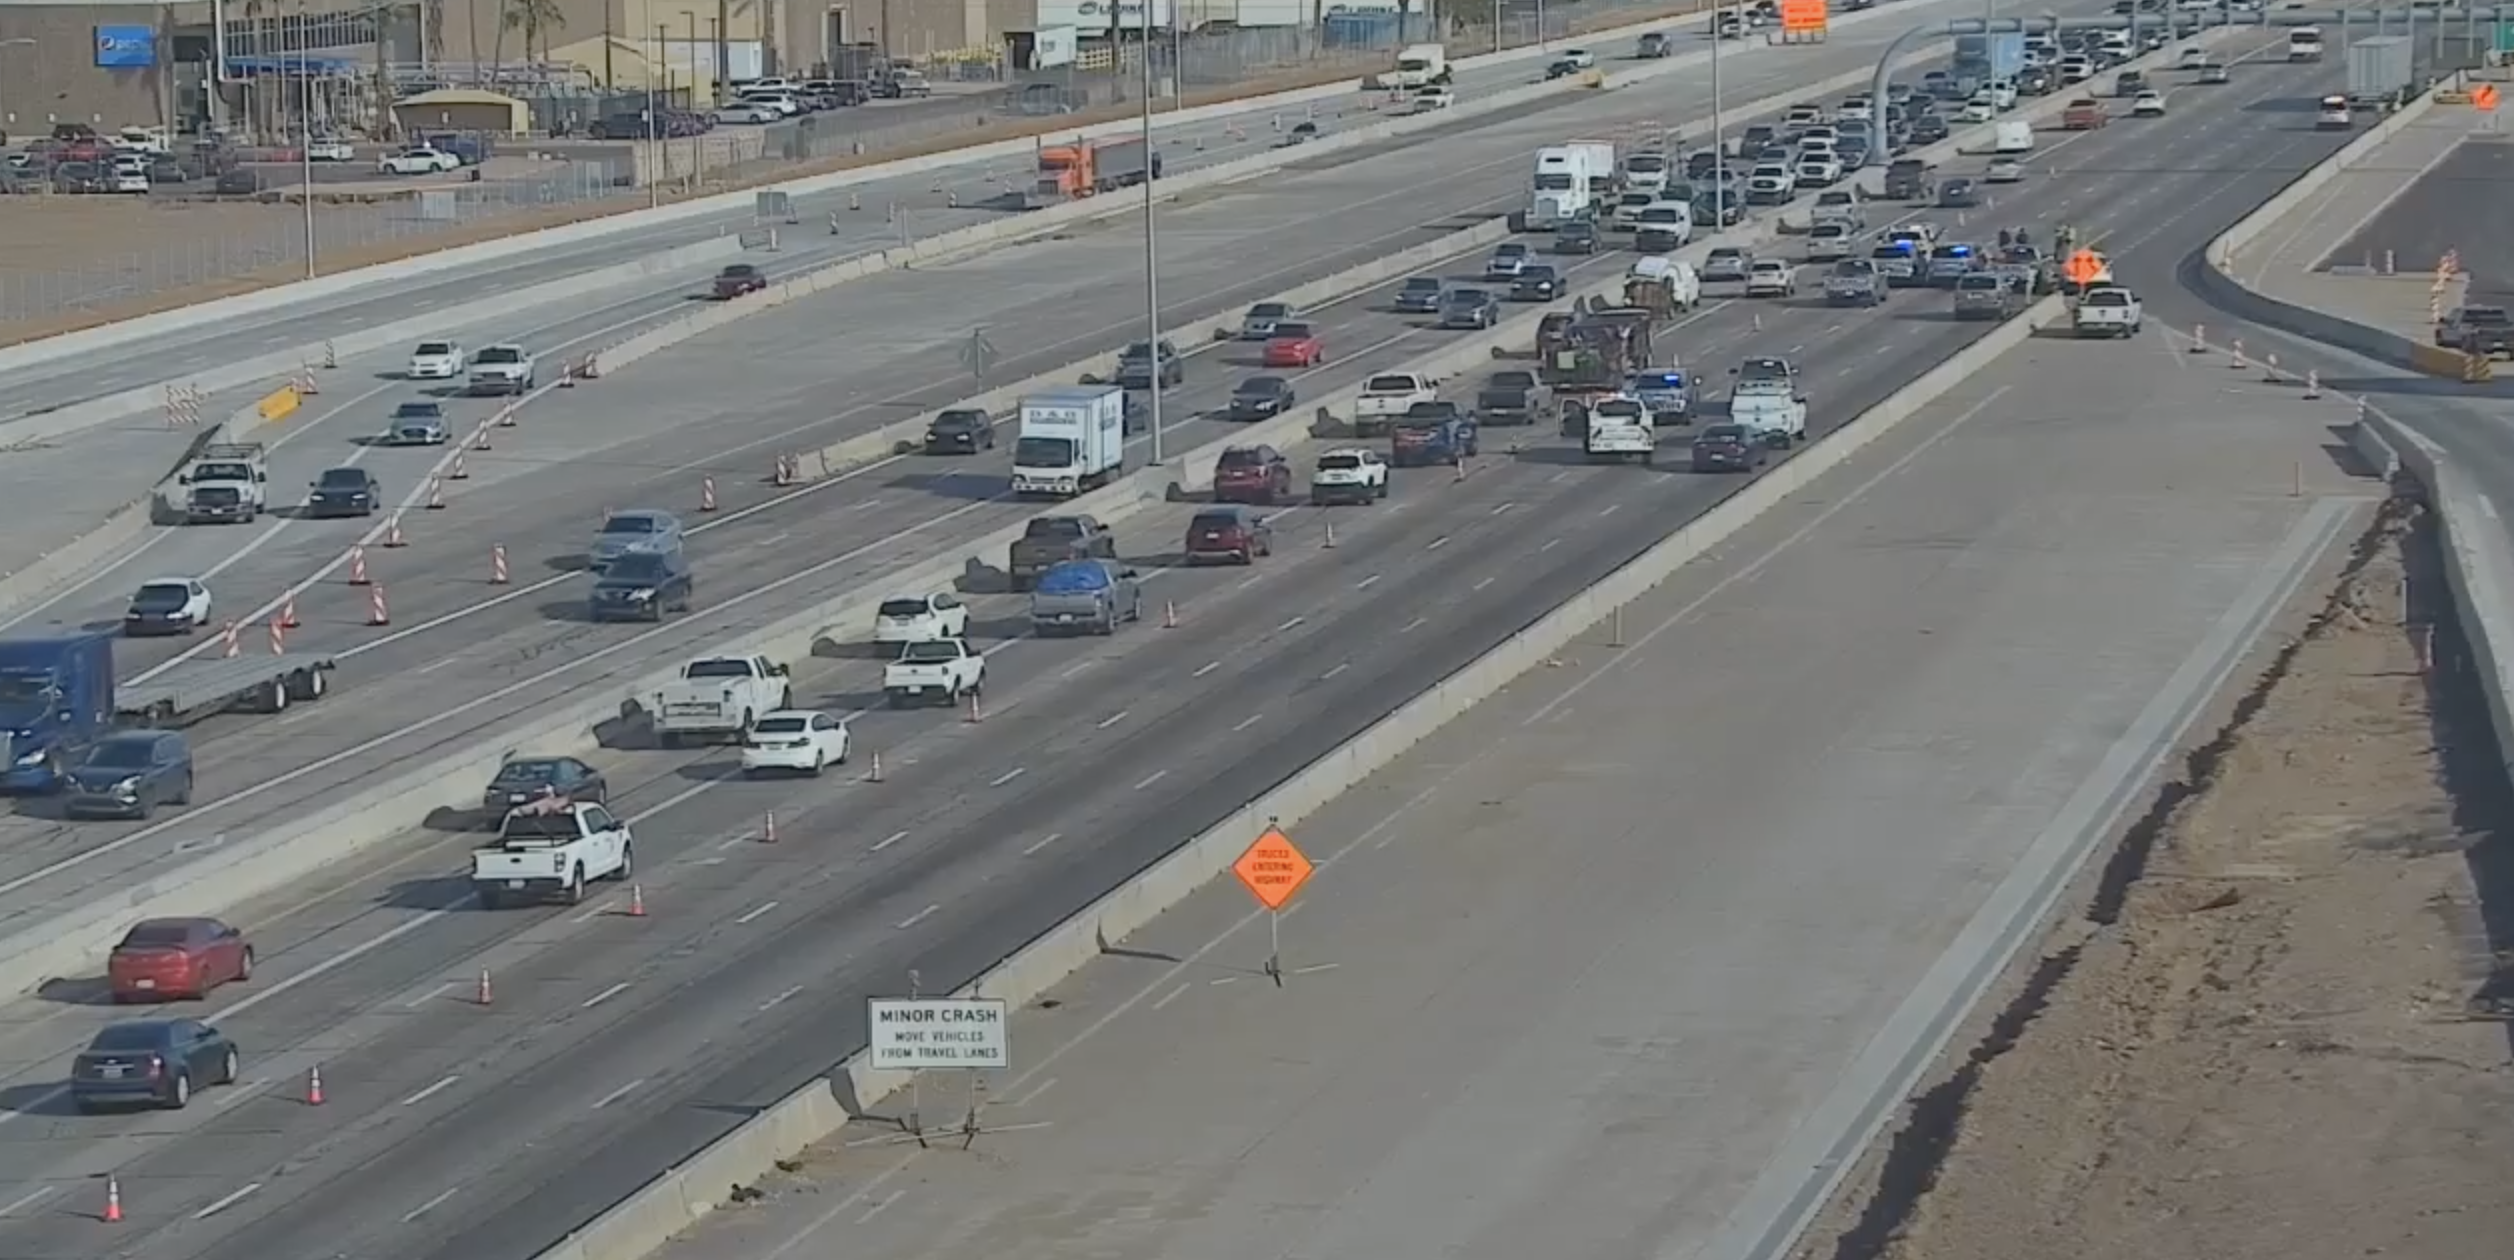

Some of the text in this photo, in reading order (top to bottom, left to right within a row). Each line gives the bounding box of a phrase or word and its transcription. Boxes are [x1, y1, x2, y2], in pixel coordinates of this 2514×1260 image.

[880, 1009, 997, 1022] MINOR CRASH
[895, 1031, 984, 1042] MOVE VEHICLES
[881, 1047, 999, 1059] FROM TRAVEL LANES
